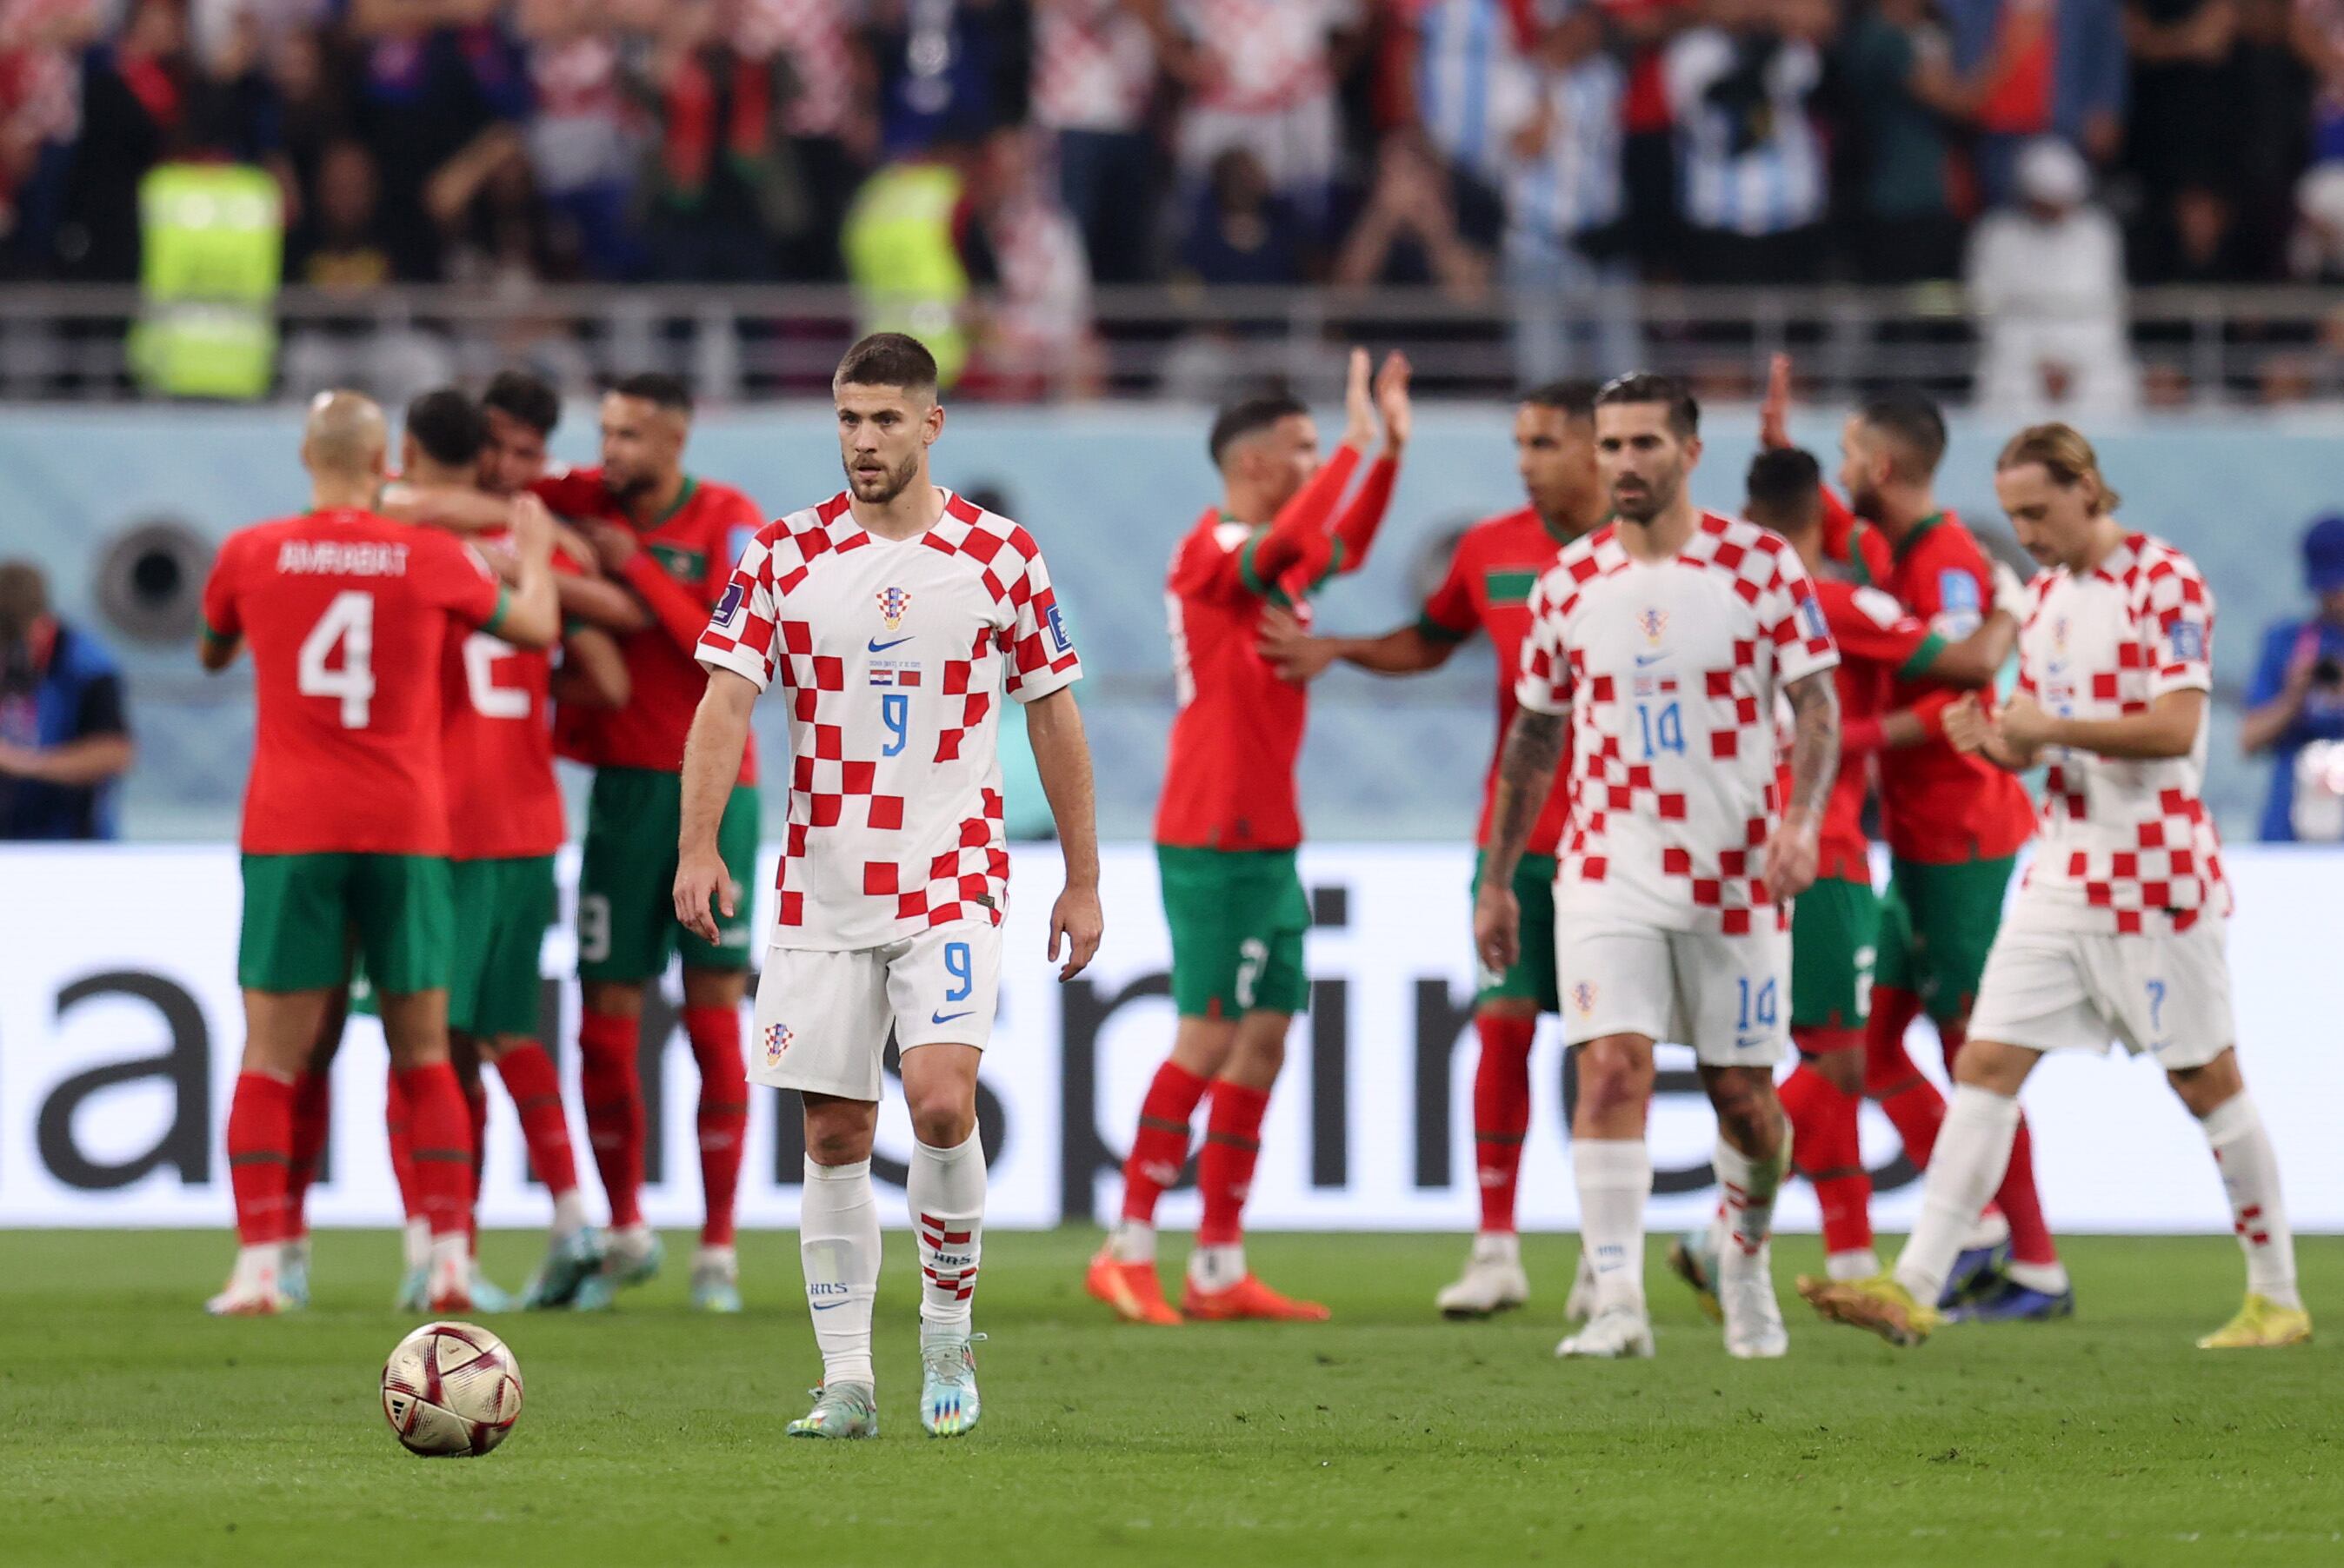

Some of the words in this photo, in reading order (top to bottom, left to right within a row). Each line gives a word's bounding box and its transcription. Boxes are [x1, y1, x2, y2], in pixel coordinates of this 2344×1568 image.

[297, 589, 375, 728] 4
[882, 694, 908, 757] 9
[1635, 700, 1685, 760] 14
[944, 942, 972, 1001] 9
[1736, 975, 1776, 1032] 14
[2144, 979, 2166, 1033] 7
